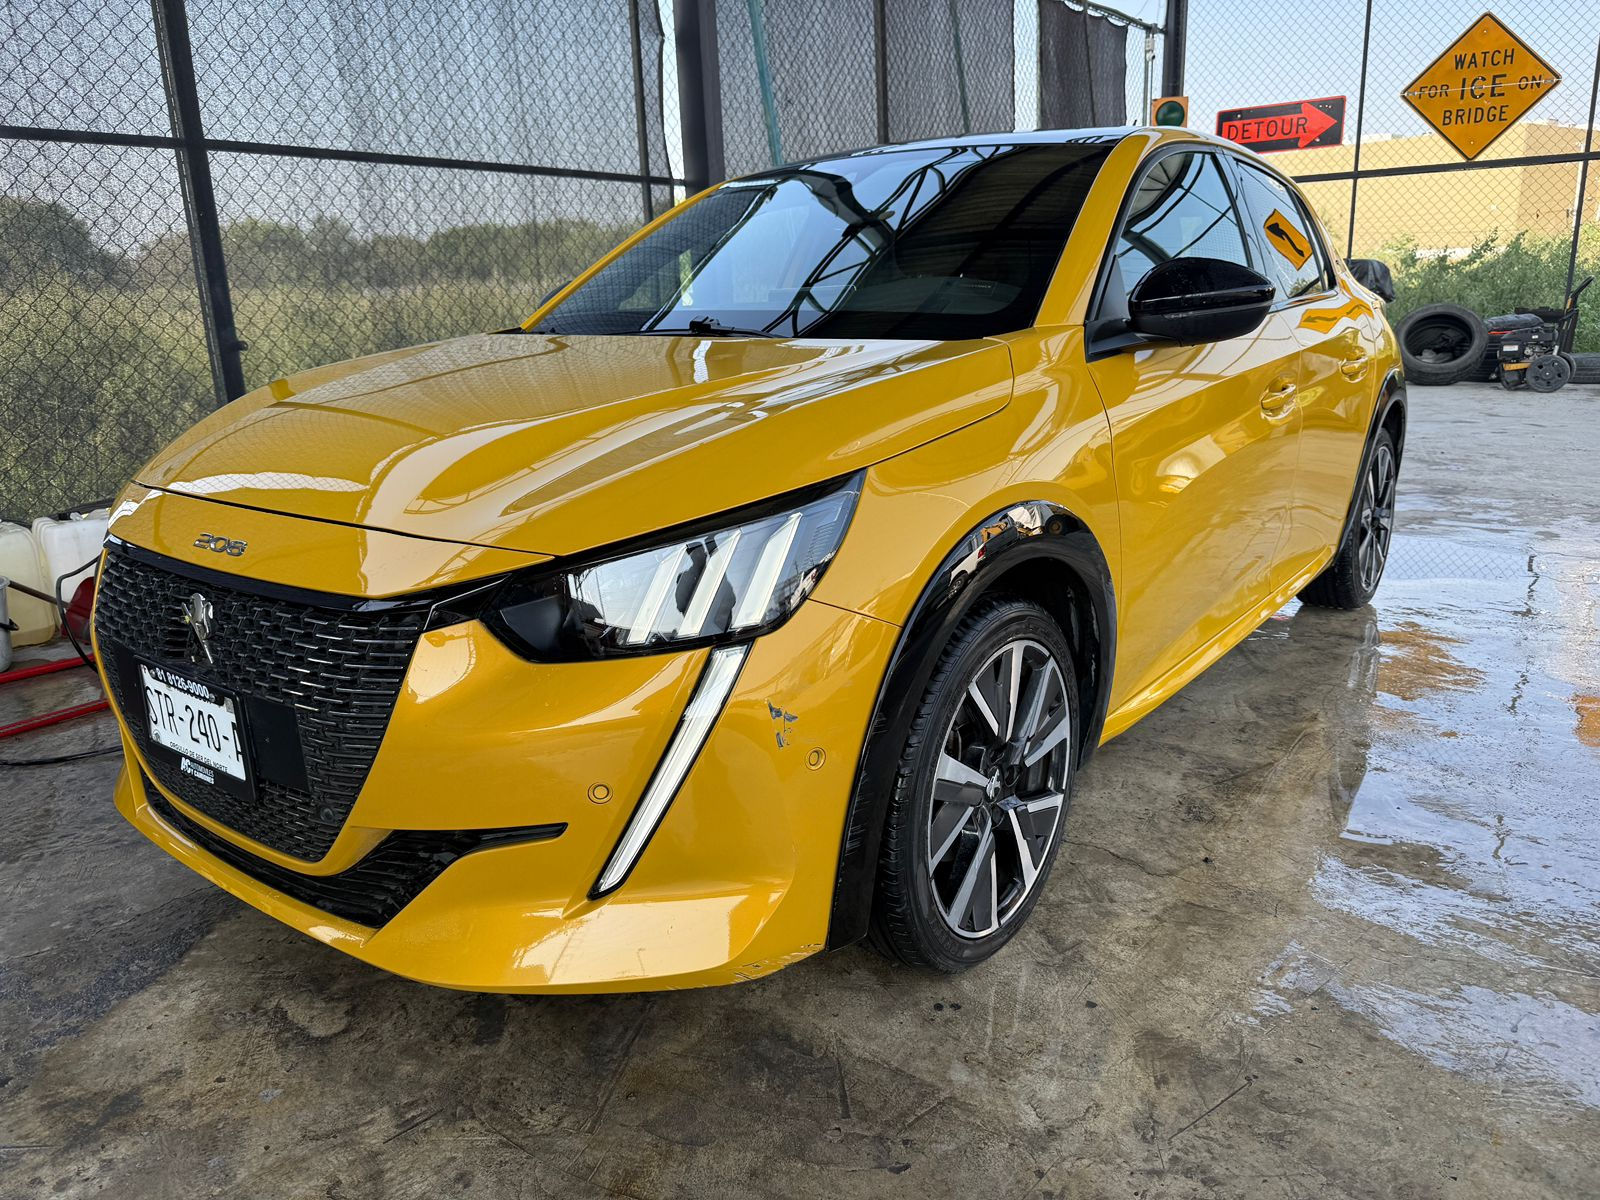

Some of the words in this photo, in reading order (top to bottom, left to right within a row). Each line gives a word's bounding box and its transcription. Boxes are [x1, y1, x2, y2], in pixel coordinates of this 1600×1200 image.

[1454, 48, 1515, 70] WATCH
[1418, 84, 1450, 99] FOR
[1460, 73, 1507, 100] ICE
[1518, 75, 1543, 91] ON
[1442, 105, 1509, 126] BRIDGE
[1227, 117, 1309, 141] DETOUR
[155, 667, 167, 682] 81
